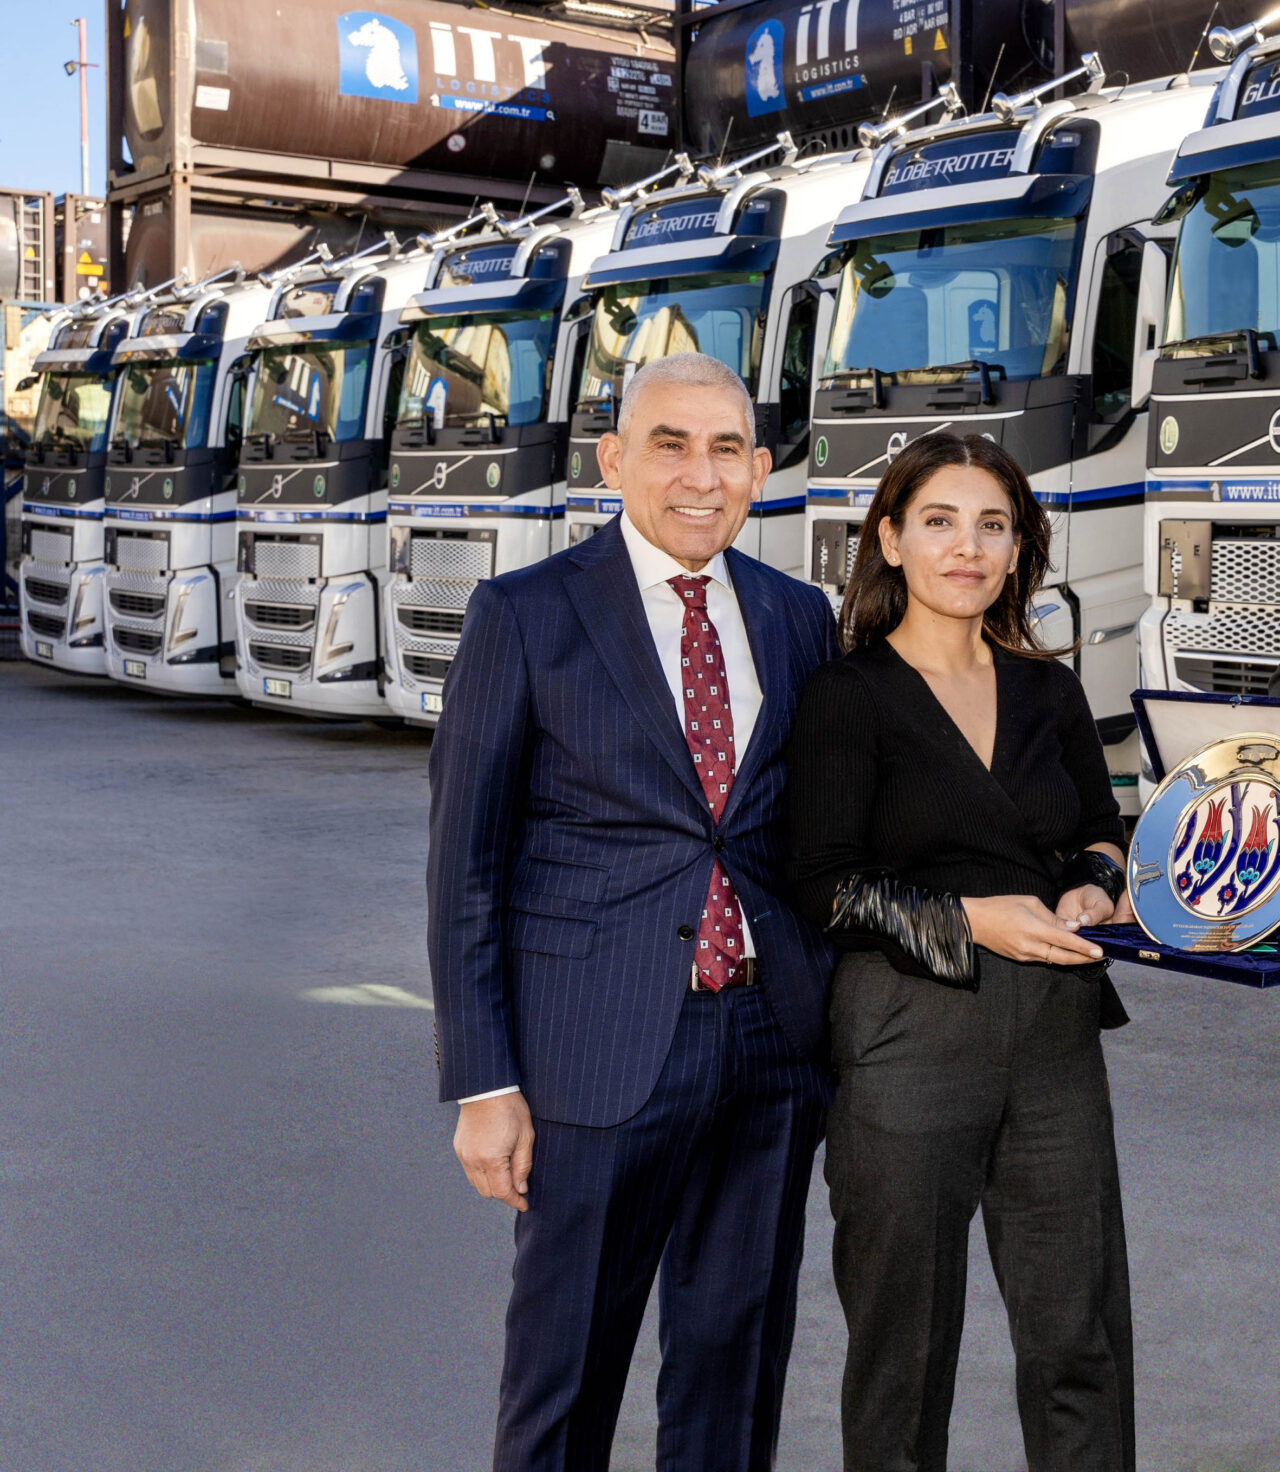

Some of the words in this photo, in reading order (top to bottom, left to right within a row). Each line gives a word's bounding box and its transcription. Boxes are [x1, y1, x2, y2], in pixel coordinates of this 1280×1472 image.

[795, 55, 860, 83] LOGISTICS
[436, 77, 551, 104] LOGISTICS
[641, 113, 649, 130] 4
[1165, 421, 1173, 447] L
